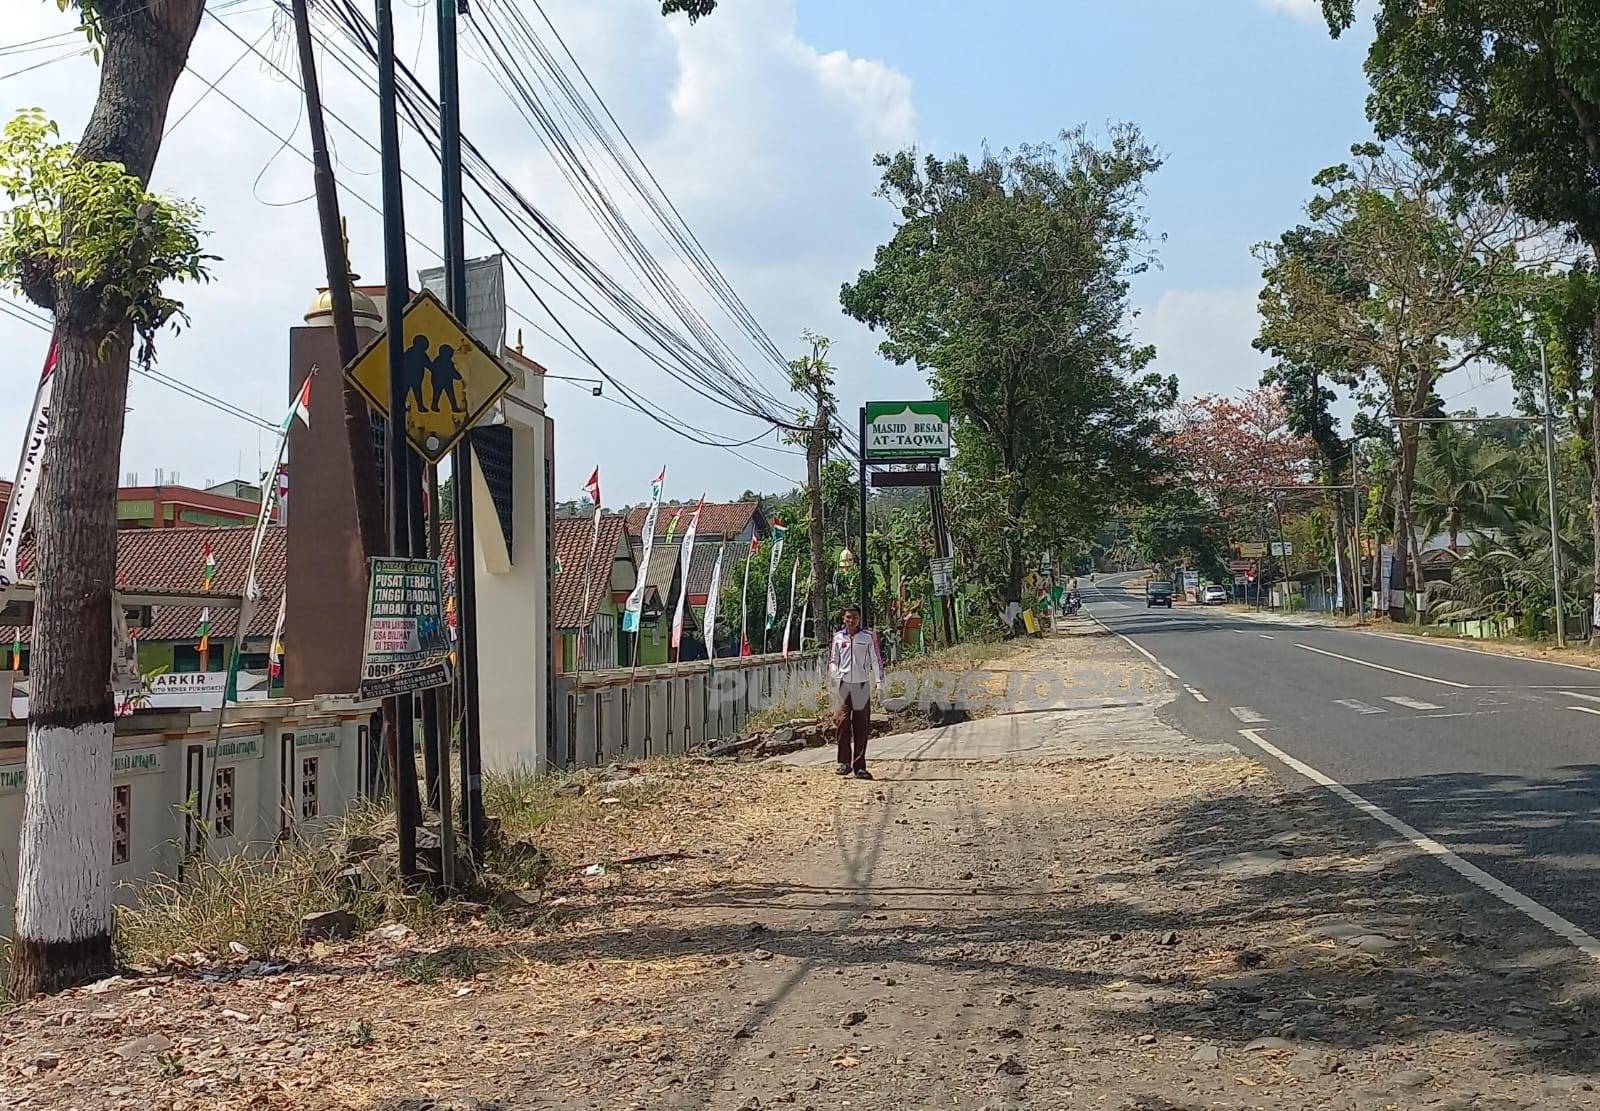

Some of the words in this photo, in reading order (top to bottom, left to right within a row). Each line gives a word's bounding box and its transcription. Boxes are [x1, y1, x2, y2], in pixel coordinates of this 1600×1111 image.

[872, 423, 907, 434] MASJID
[913, 422, 944, 433] BESAR
[872, 435, 944, 447] AT-TAQWA
[375, 574, 404, 587] PUSAT
[405, 575, 435, 589] TERAPI
[374, 588, 405, 602] TINGGI
[405, 589, 437, 603] BADAN
[372, 603, 407, 615] TAMBAH
[423, 603, 439, 616] CM
[367, 664, 396, 678] 0896
